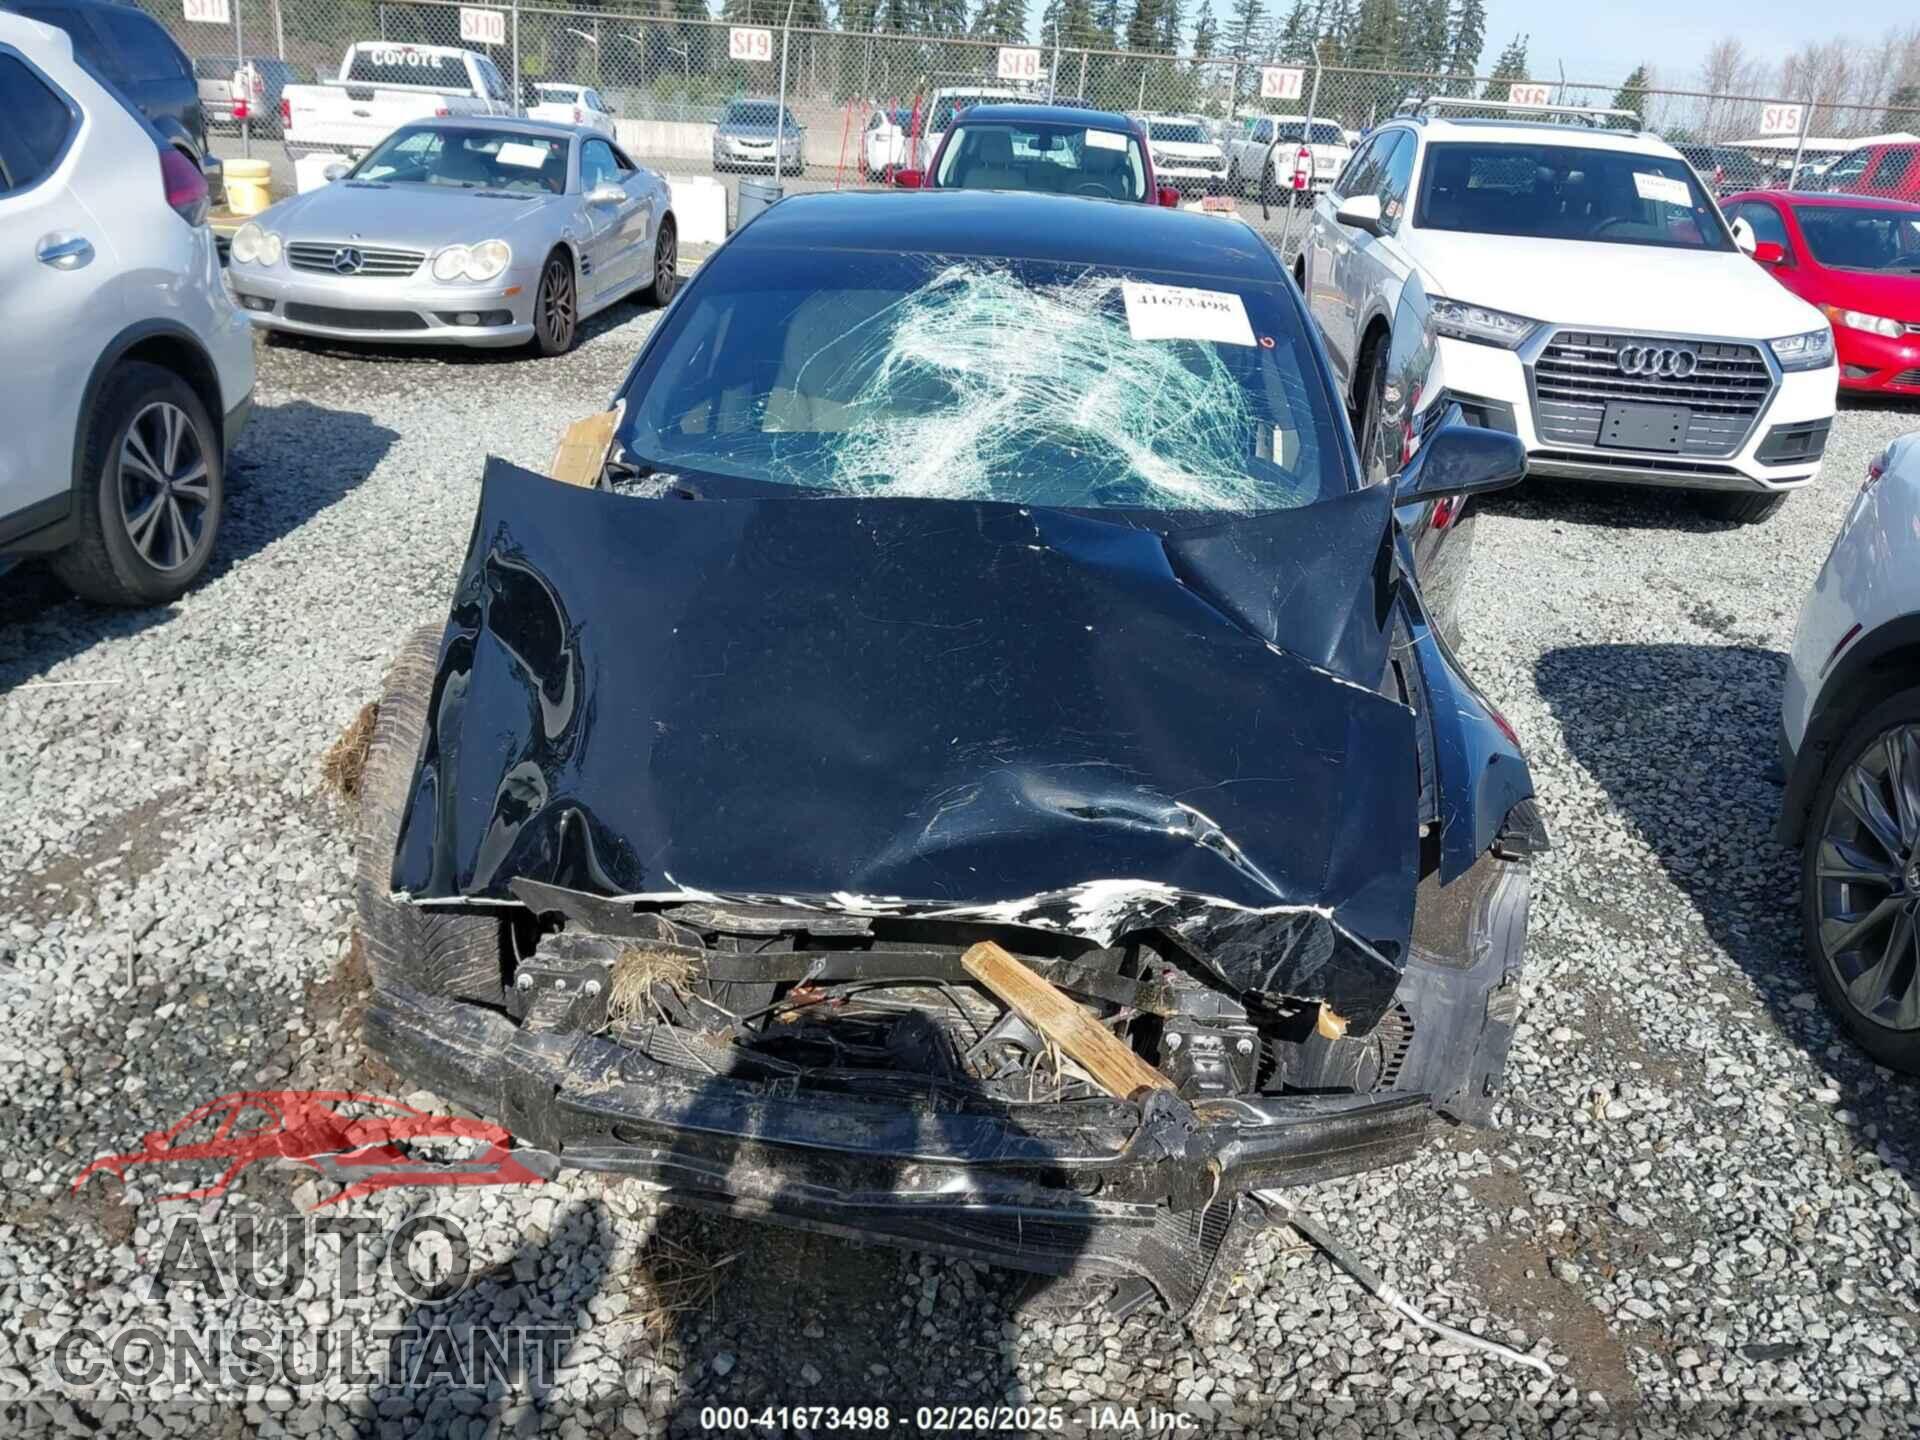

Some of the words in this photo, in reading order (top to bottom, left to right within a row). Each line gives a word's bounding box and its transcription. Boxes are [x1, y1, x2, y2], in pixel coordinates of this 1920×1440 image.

[463, 13, 501, 38] SF10
[735, 31, 768, 56] SF9
[371, 49, 442, 68] COYOTE
[1003, 52, 1036, 76] SF8
[1267, 72, 1298, 95] SF7
[1765, 108, 1797, 130] SF5
